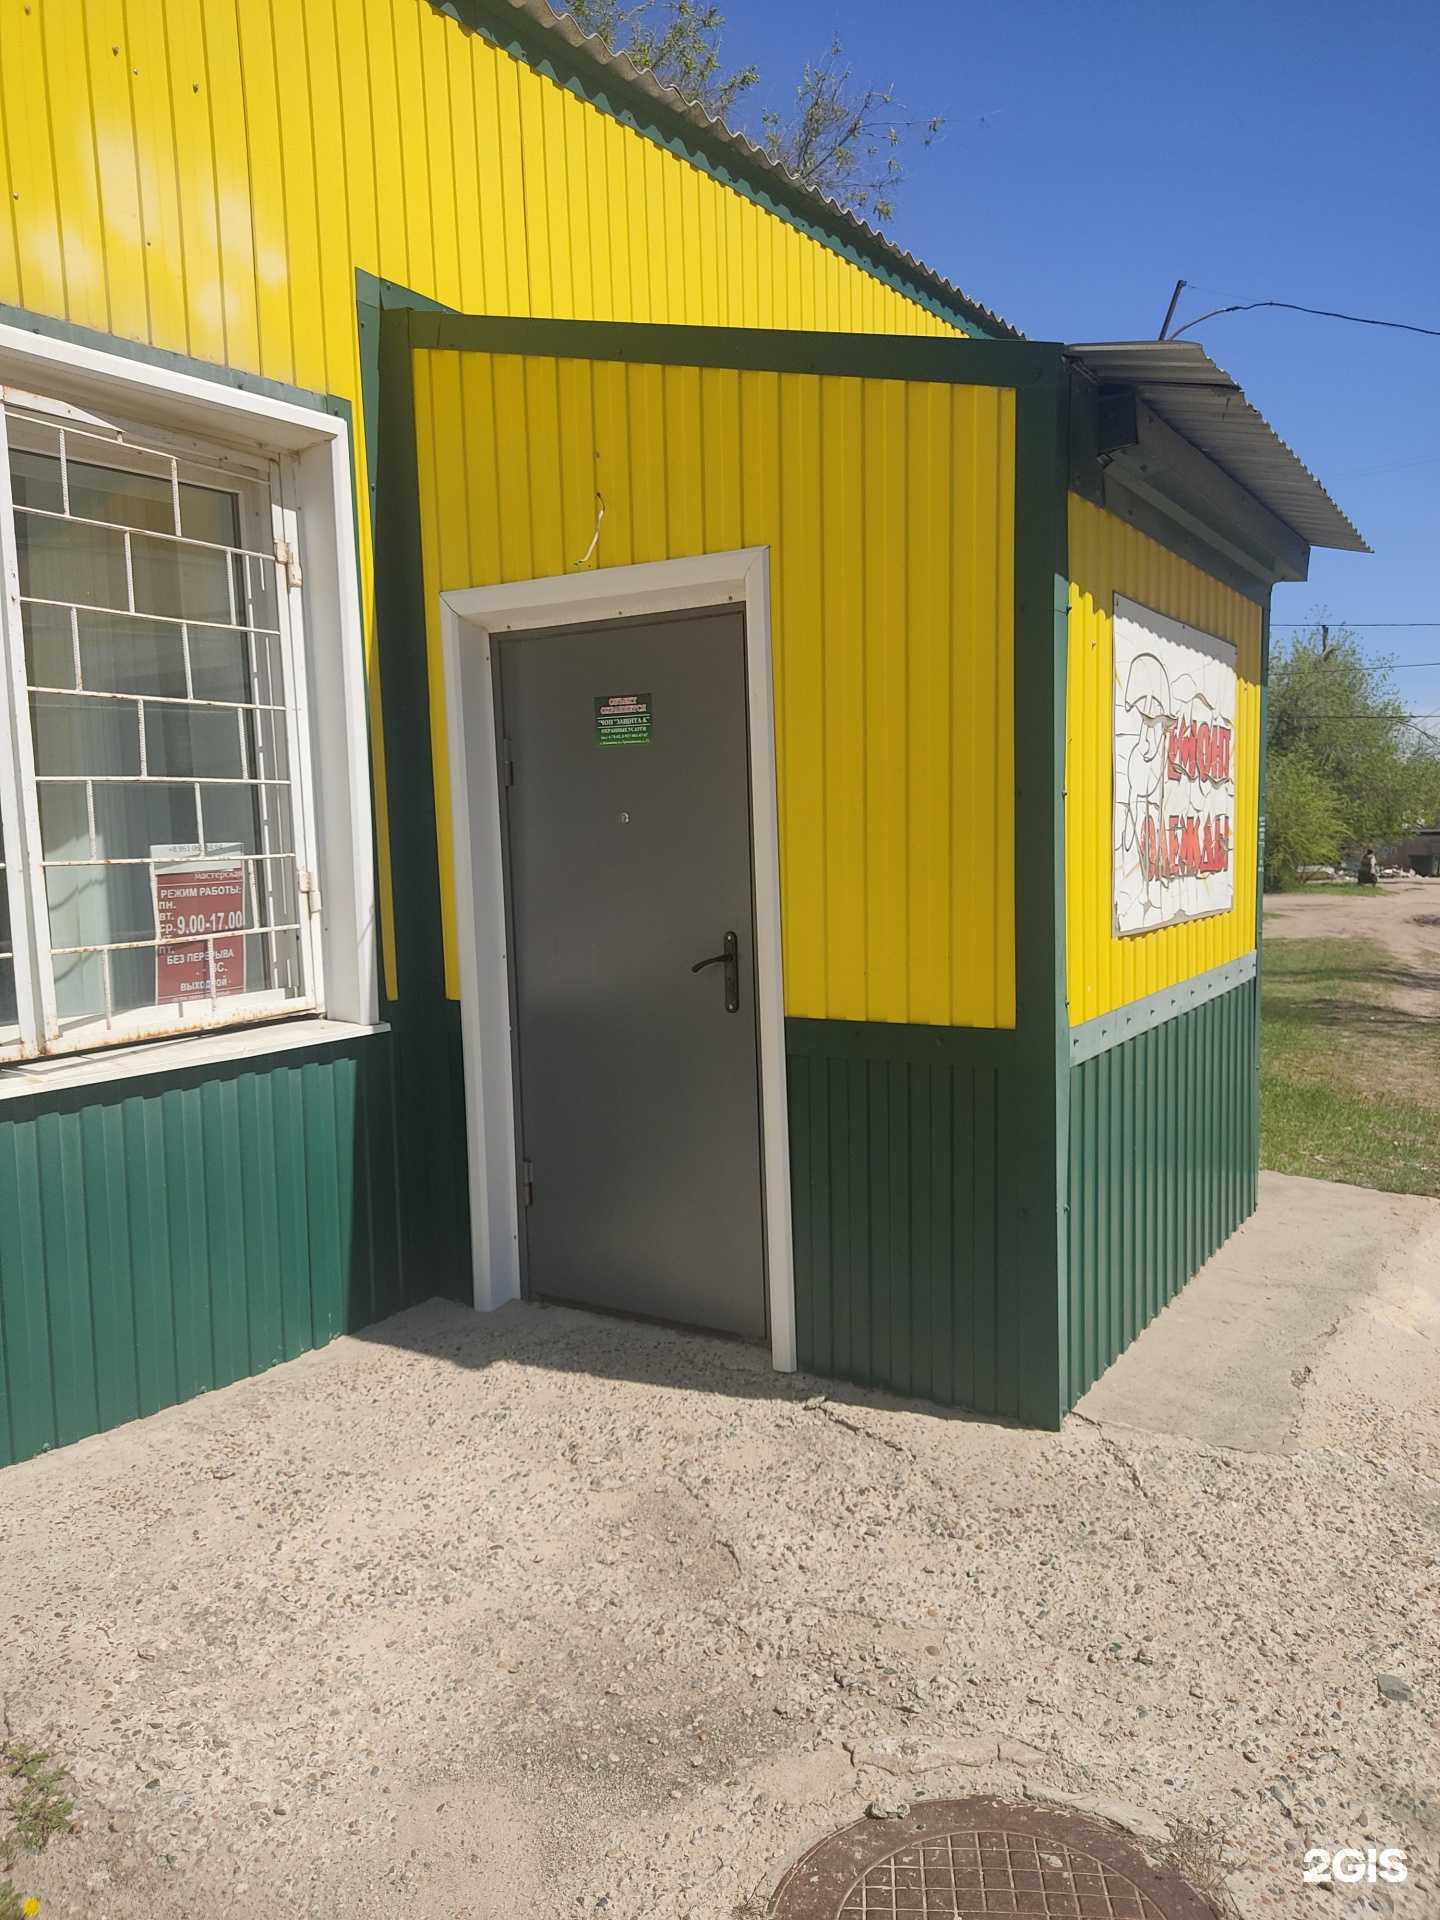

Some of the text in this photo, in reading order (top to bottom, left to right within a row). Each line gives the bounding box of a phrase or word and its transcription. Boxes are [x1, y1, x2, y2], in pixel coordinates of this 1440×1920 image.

[160, 885, 242, 899] РЕЖИМ РАБОТЫ:
[177, 910, 243, 935] 9.00-17.00
[166, 954, 185, 966] БЕЗ
